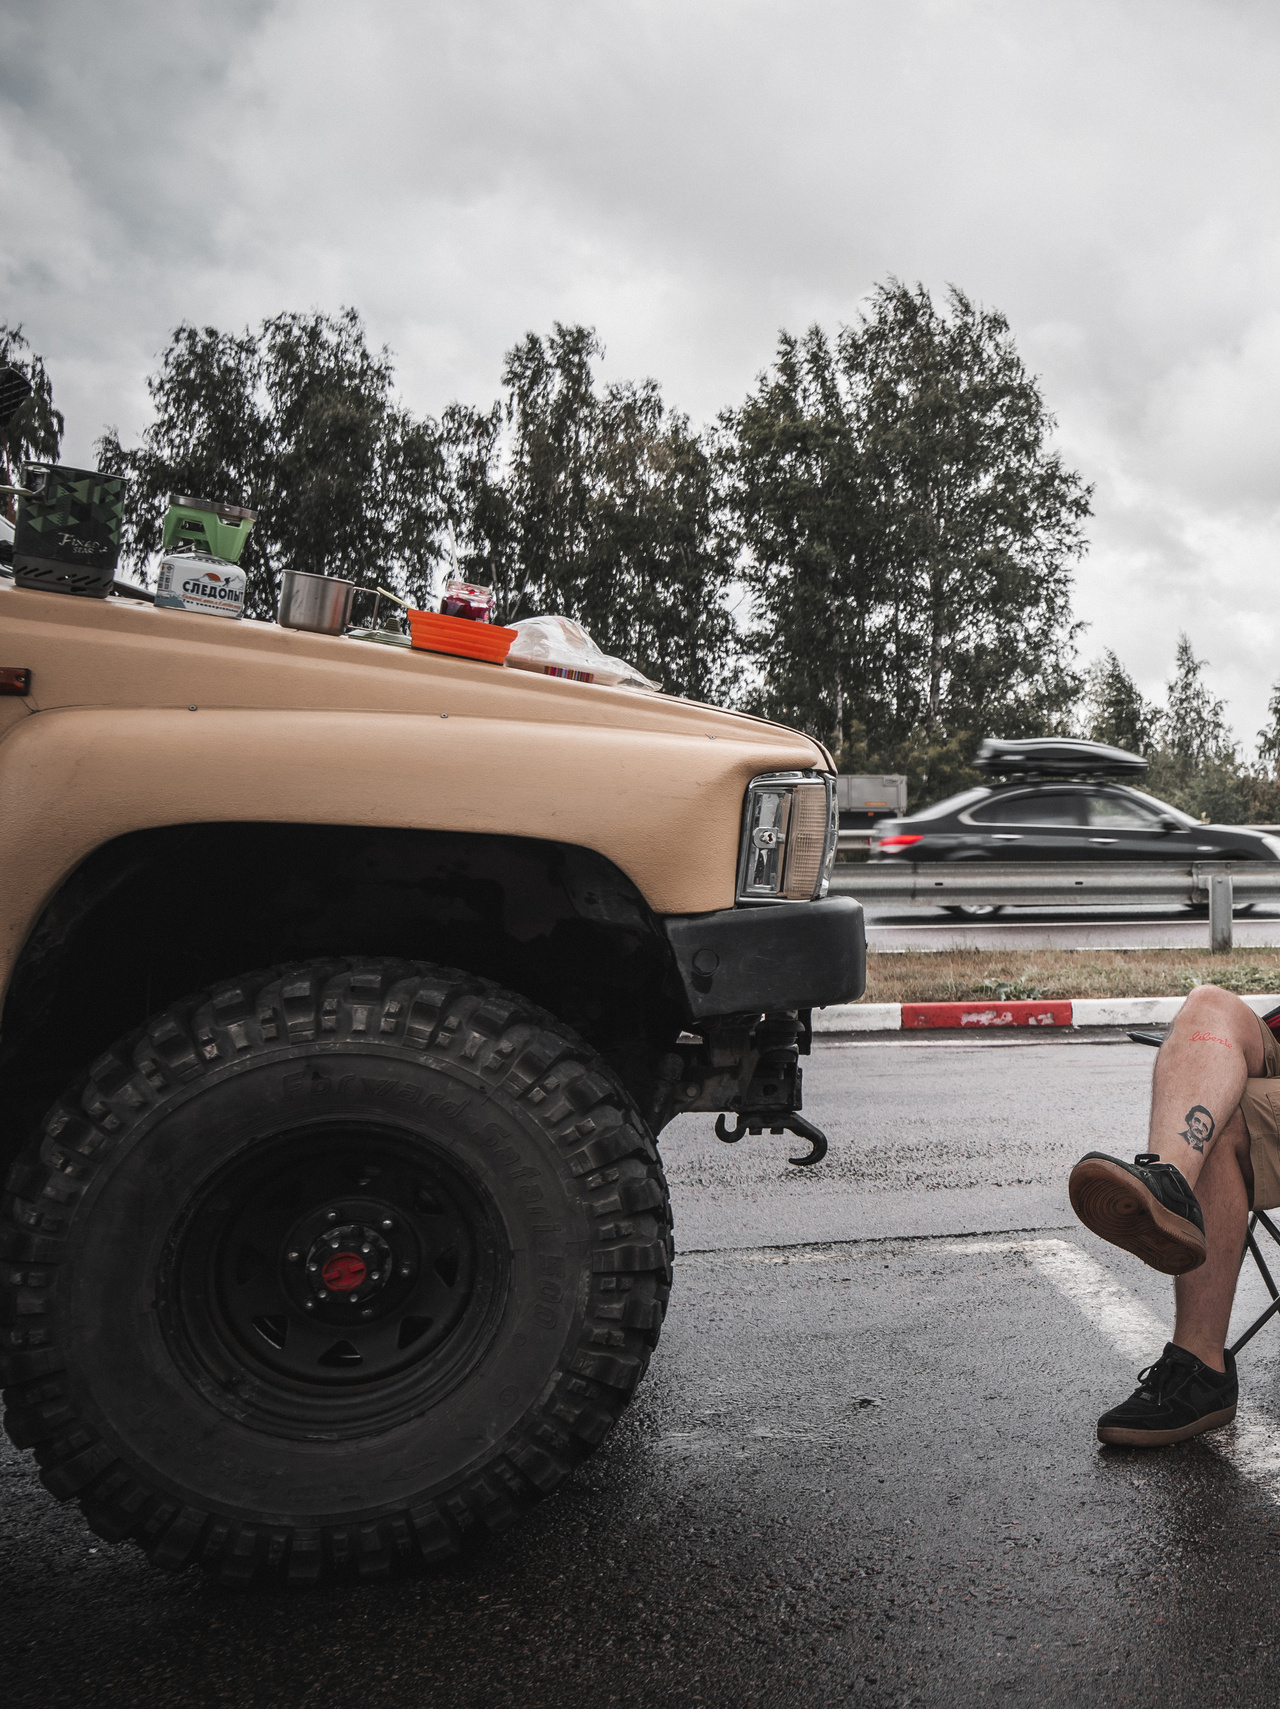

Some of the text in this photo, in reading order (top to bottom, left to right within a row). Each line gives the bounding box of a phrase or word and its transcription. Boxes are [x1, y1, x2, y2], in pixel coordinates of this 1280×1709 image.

[281, 1070, 566, 1331] Forward Safari 500
